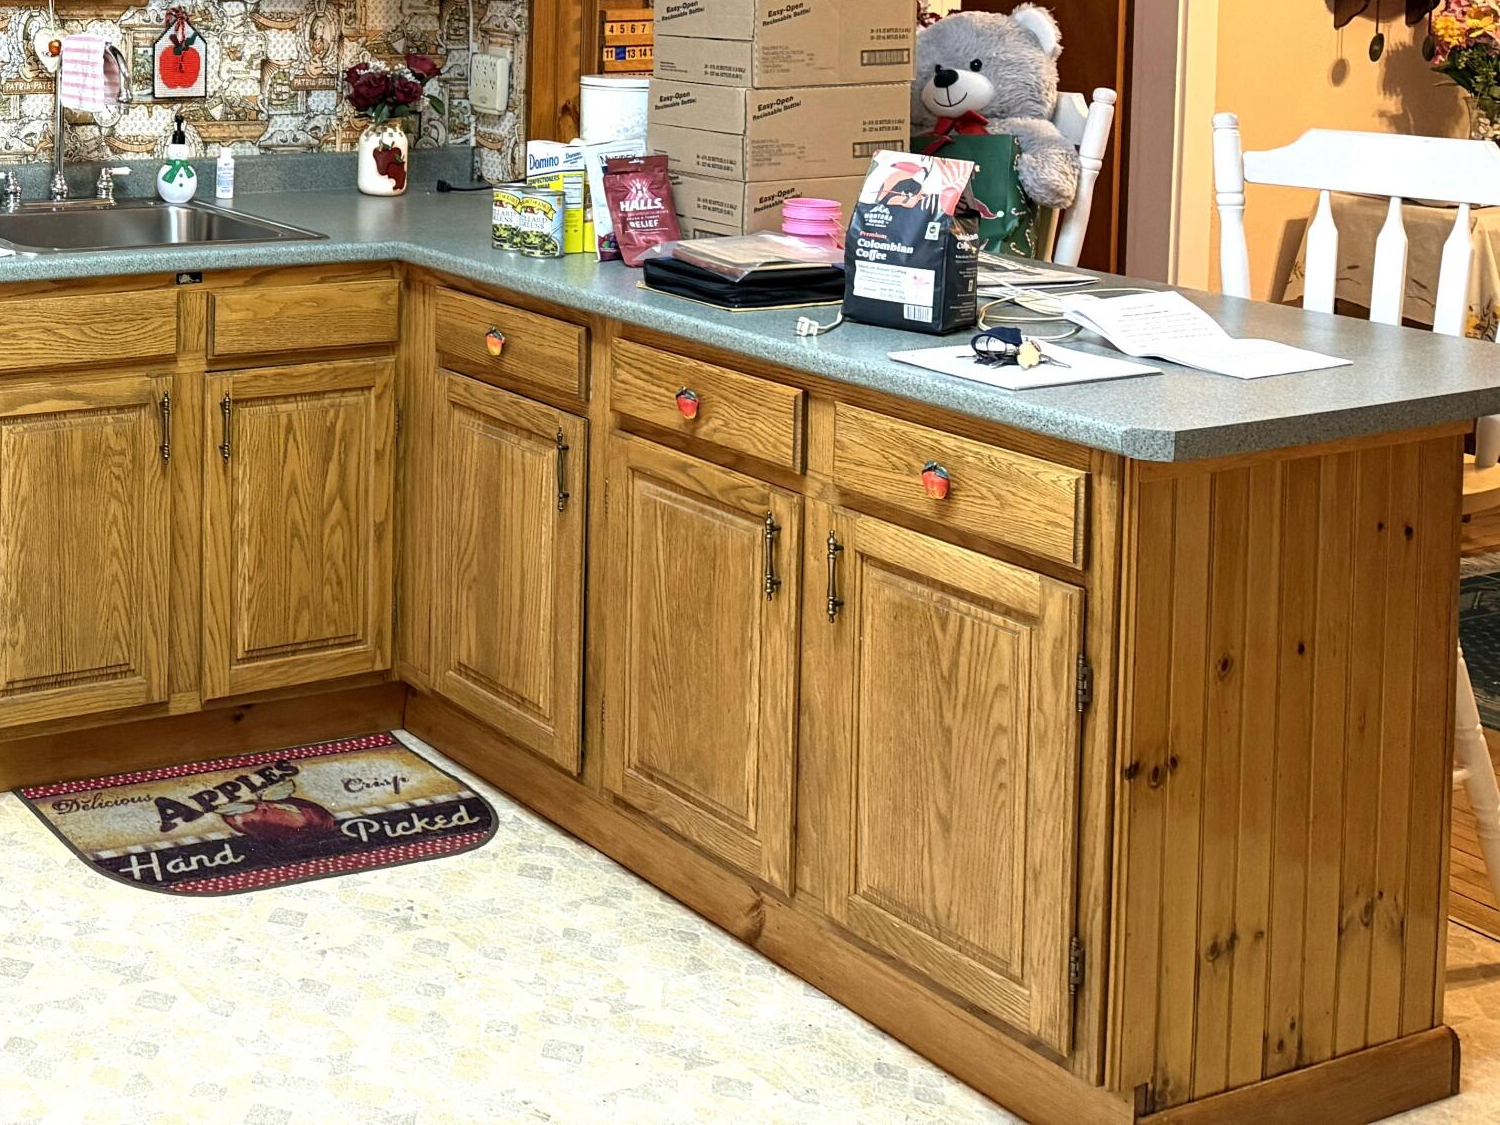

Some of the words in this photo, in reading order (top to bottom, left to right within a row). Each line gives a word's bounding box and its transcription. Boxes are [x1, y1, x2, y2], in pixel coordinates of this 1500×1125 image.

[666, 1, 699, 13] Easy-Open
[768, 2, 804, 17] Easy-Open
[619, 24, 625, 34] 5
[630, 24, 636, 34] 6
[641, 24, 646, 33] 7
[605, 49, 613, 59] 11
[626, 48, 636, 58] 13
[638, 48, 647, 58] 14
[6, 82, 31, 91] PATRIA
[757, 95, 794, 112] Easy-Open
[529, 154, 560, 171] Domino
[759, 187, 795, 204] Easy-Open
[619, 197, 663, 212] HALLS
[629, 219, 659, 229] RELIEF
[857, 238, 914, 254] Colombian
[856, 248, 888, 261] Coffee
[52, 793, 154, 815] Delicious
[341, 775, 409, 794] Crisp
[154, 759, 300, 833] APPLES
[119, 843, 245, 882] Hand
[340, 804, 480, 842] Picked
